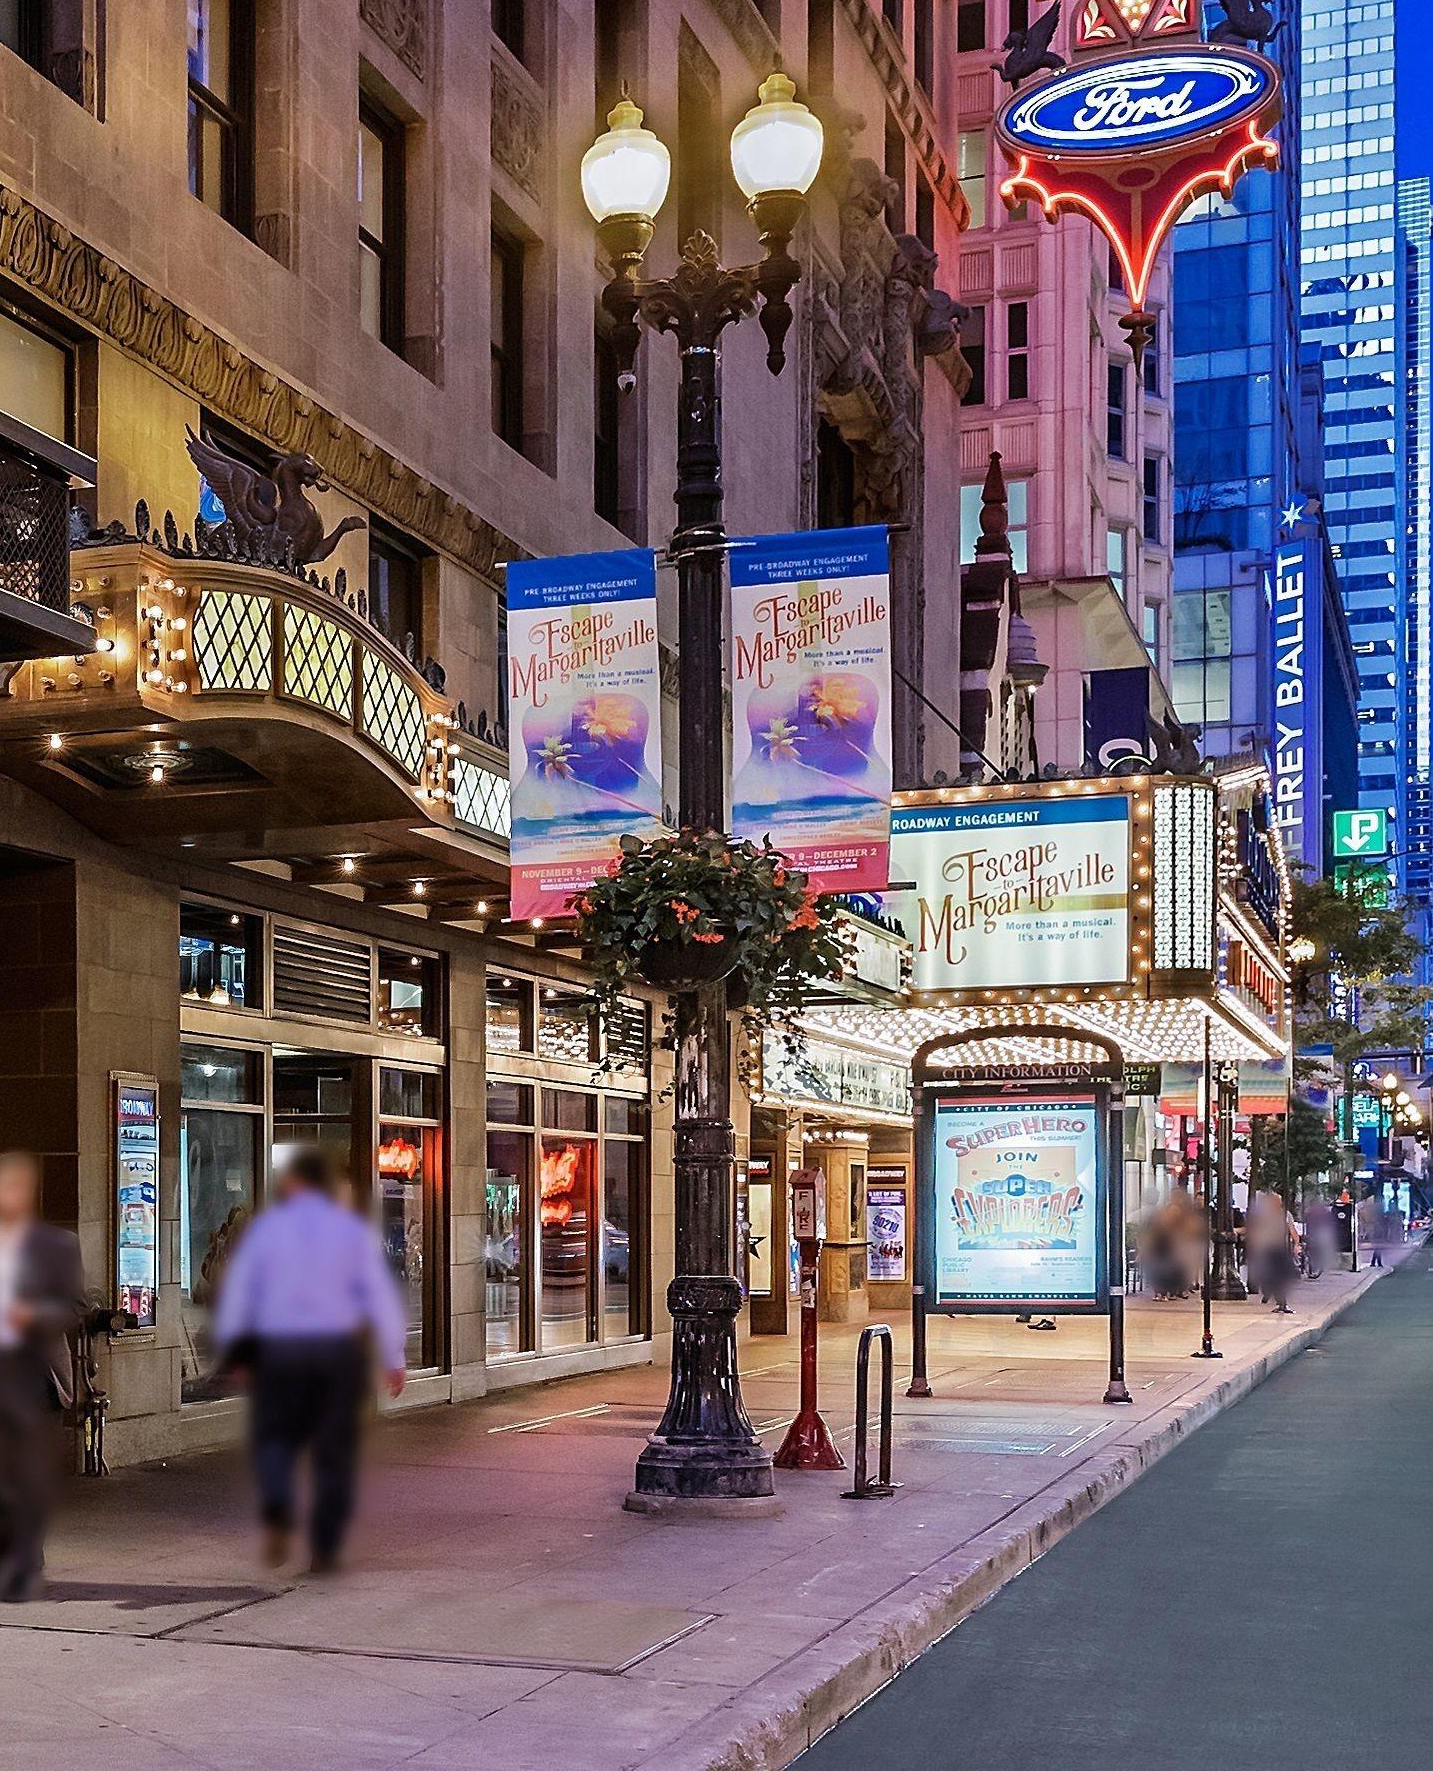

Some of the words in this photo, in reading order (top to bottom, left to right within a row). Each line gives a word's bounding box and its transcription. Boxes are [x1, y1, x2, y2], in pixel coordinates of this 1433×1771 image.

[1073, 75, 1196, 131] Ford
[813, 553, 869, 565] ENGAGEMENT
[768, 570, 792, 579] THREE
[795, 568, 823, 576] WEEKS
[826, 565, 850, 573] ONLY!
[586, 578, 638, 590] ENGAGEMENT
[543, 594, 567, 603] THREE
[569, 592, 596, 601] WEEKS
[753, 587, 842, 638] Escape
[528, 611, 614, 659] Escape
[1276, 549, 1304, 707] BALLET
[735, 596, 886, 690] Margaritaville
[804, 651, 823, 659] More
[826, 649, 843, 657] than
[510, 619, 655, 708] Margaritaville
[835, 659, 849, 667] way
[851, 657, 860, 665] of
[577, 672, 596, 680] More
[607, 680, 620, 688] way
[892, 816, 950, 831] ROADWAY
[955, 810, 1040, 827] ENGAGEMENT
[870, 847, 878, 857] 2
[814, 858, 858, 866] THEATRE
[521, 868, 573, 879] NOVEMBER
[942, 840, 1058, 902] Escape
[540, 876, 587, 884] ORIENTAL
[917, 853, 1115, 966] Margaritaville
[1005, 920, 1032, 931] More
[1035, 919, 1060, 930] than
[1062, 920, 1069, 928] a
[1072, 916, 1116, 928] musical.
[1017, 932, 1034, 942] It's
[1037, 933, 1044, 941] a
[1047, 932, 1066, 942] way
[1069, 930, 1081, 940] of
[1083, 929, 1104, 940] life.
[942, 1068, 978, 1080] CITY
[984, 1063, 1092, 1078] INFORMATION
[995, 1151, 1039, 1164] JOIN
[982, 1178, 1052, 1196] SUPER
[951, 1186, 1084, 1235] EXPLORERS
